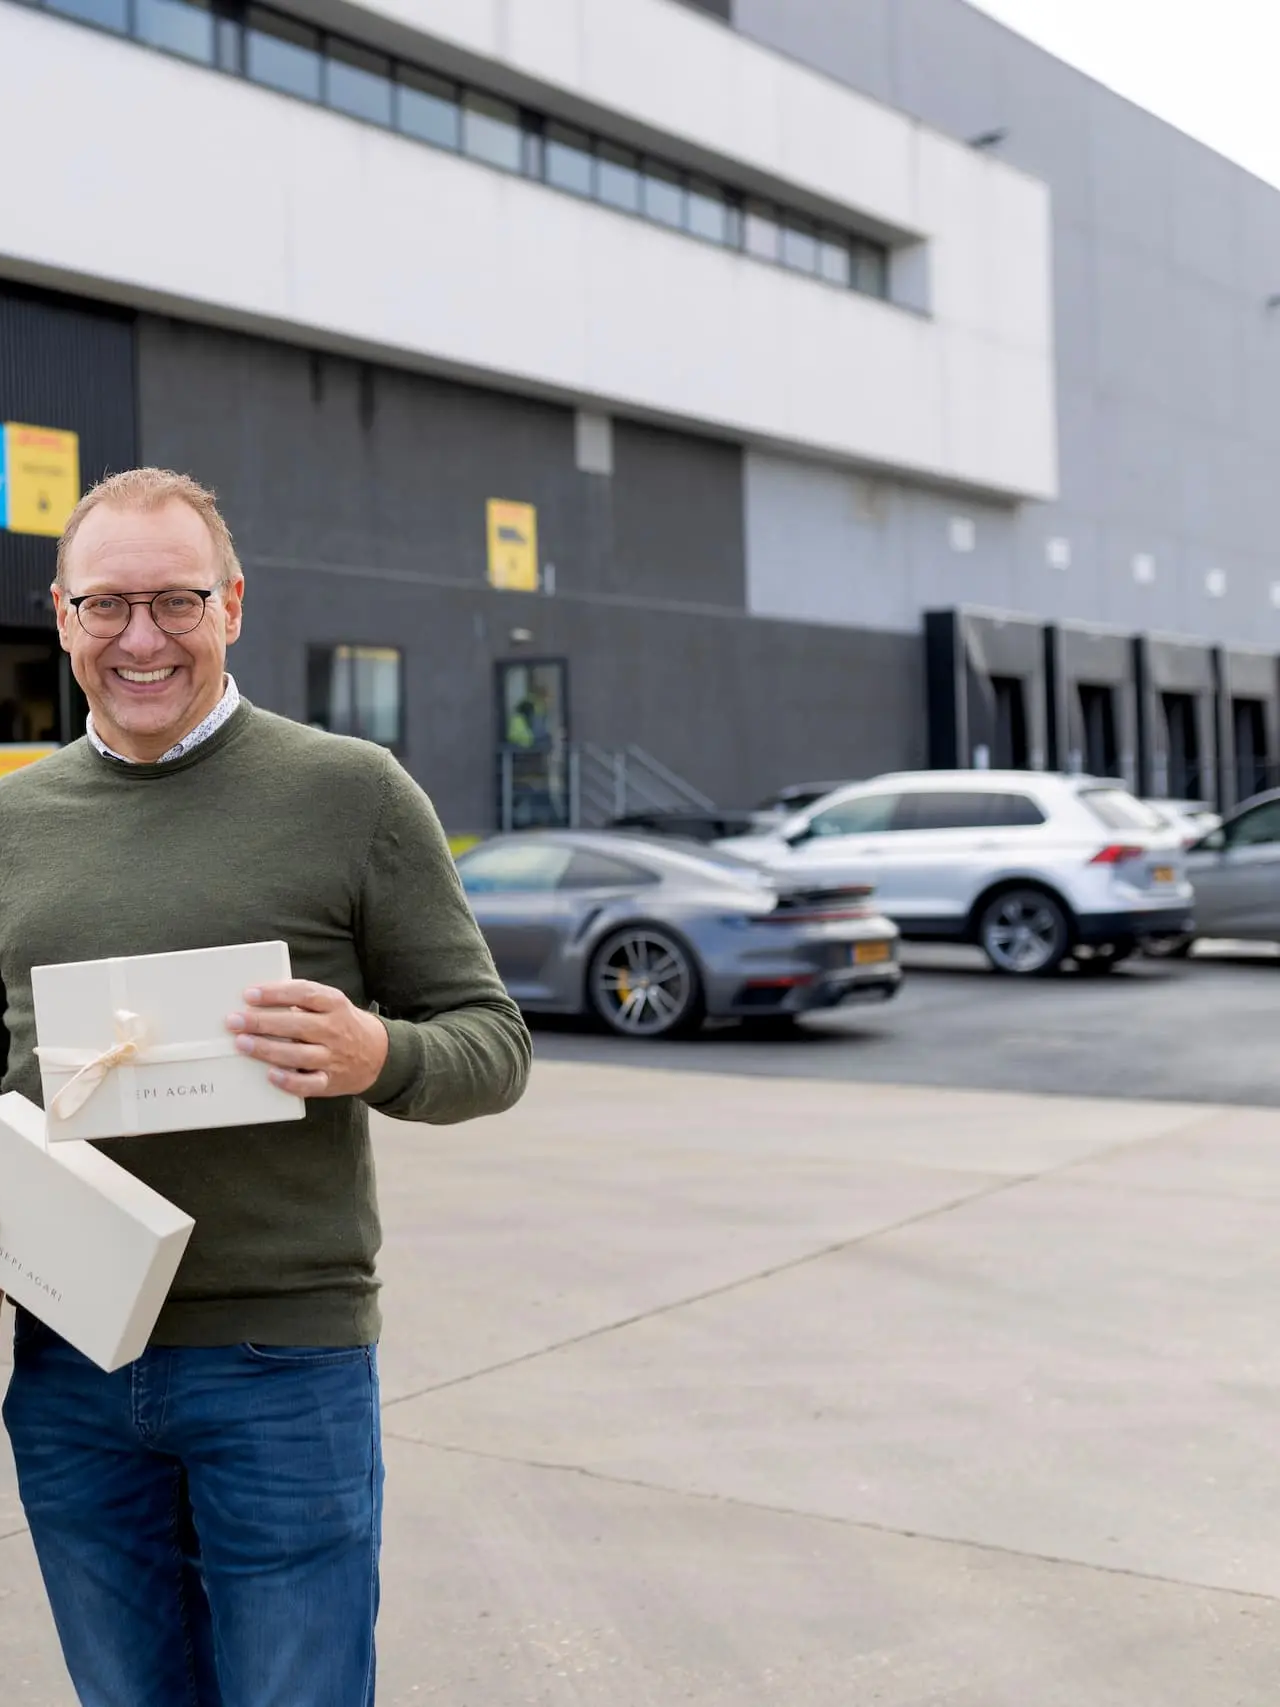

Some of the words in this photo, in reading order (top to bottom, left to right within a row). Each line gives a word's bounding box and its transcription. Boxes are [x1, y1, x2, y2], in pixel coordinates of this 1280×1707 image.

[135, 1087, 157, 1100] EPI
[165, 1081, 215, 1098] AGARI
[25, 1271, 63, 1303] AGARI
